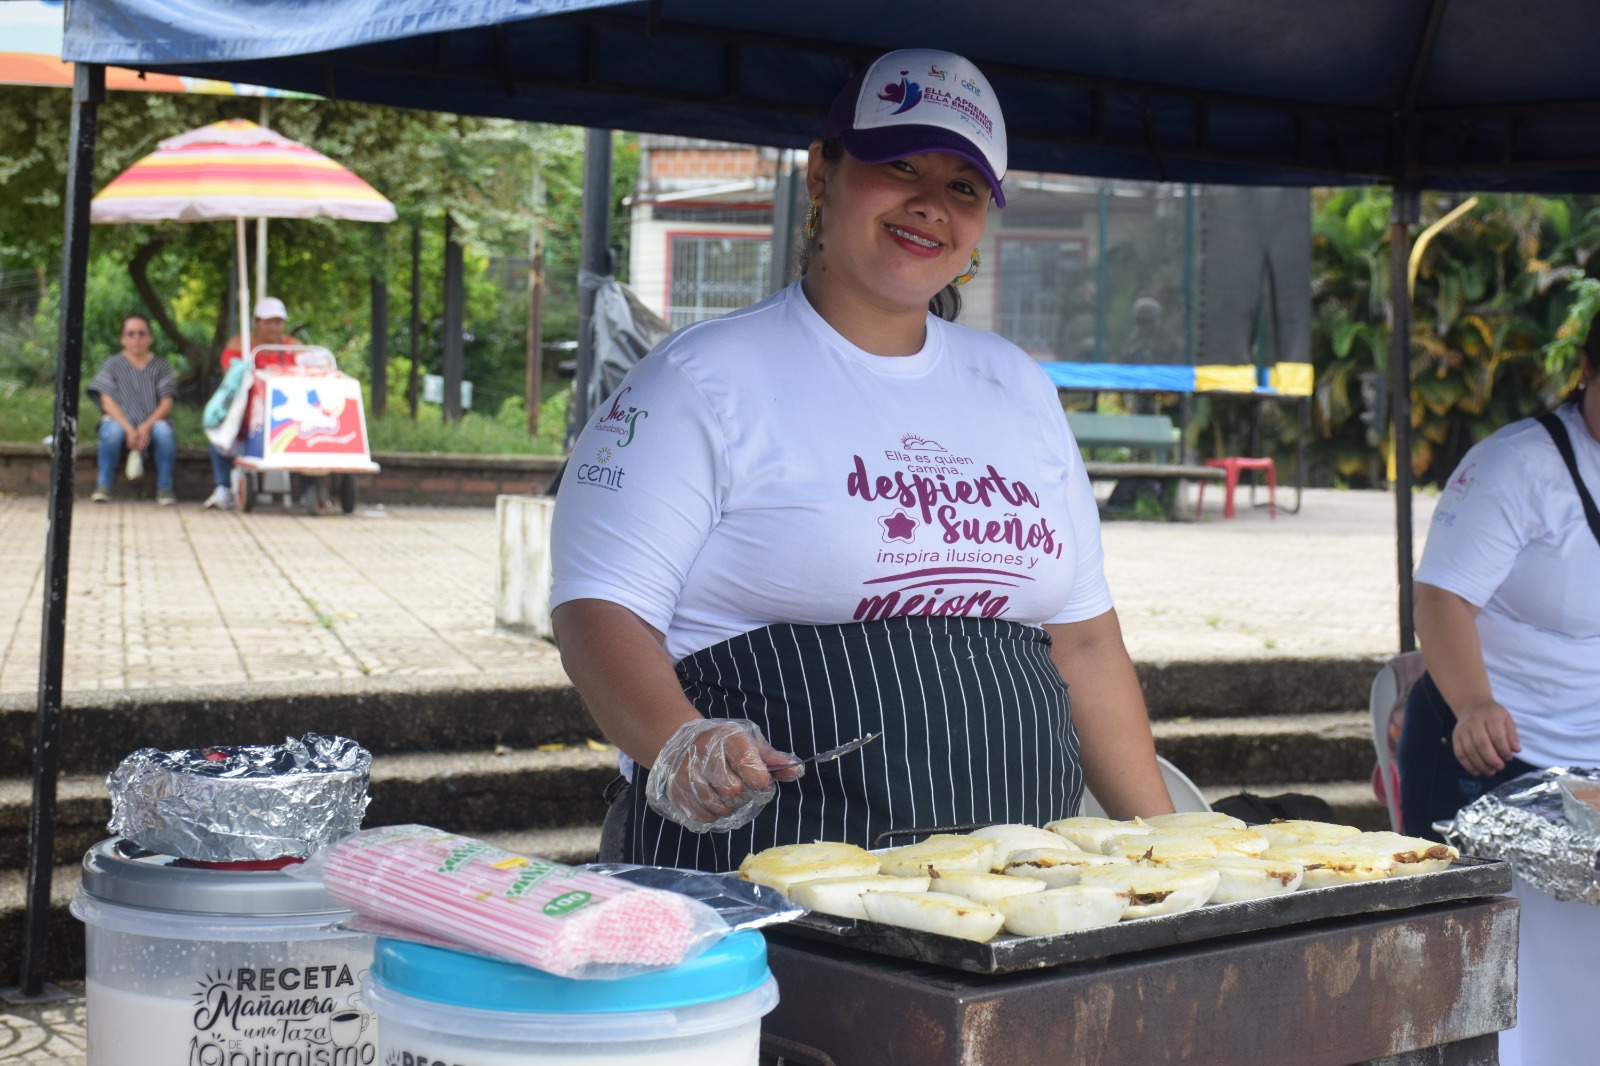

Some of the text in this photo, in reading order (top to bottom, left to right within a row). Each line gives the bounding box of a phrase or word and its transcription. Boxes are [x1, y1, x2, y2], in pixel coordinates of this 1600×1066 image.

[924, 94, 949, 104] ELLA
[951, 100, 993, 134] EMPRENDE
[925, 87, 952, 99] ELLA
[955, 96, 993, 126] APRENDE
[594, 423, 629, 436] Foundation
[885, 450, 974, 468] Ella es quien
[577, 463, 625, 488] cenit
[847, 454, 1040, 524] despierta
[937, 505, 1062, 559] Sueños,
[876, 549, 1039, 569] inspira ilusiones y
[546, 893, 586, 911] 100
[236, 963, 354, 991] RECETA
[193, 990, 338, 1031] Mañanera
[243, 1018, 327, 1044] una Taza
[228, 1039, 242, 1050] DE
